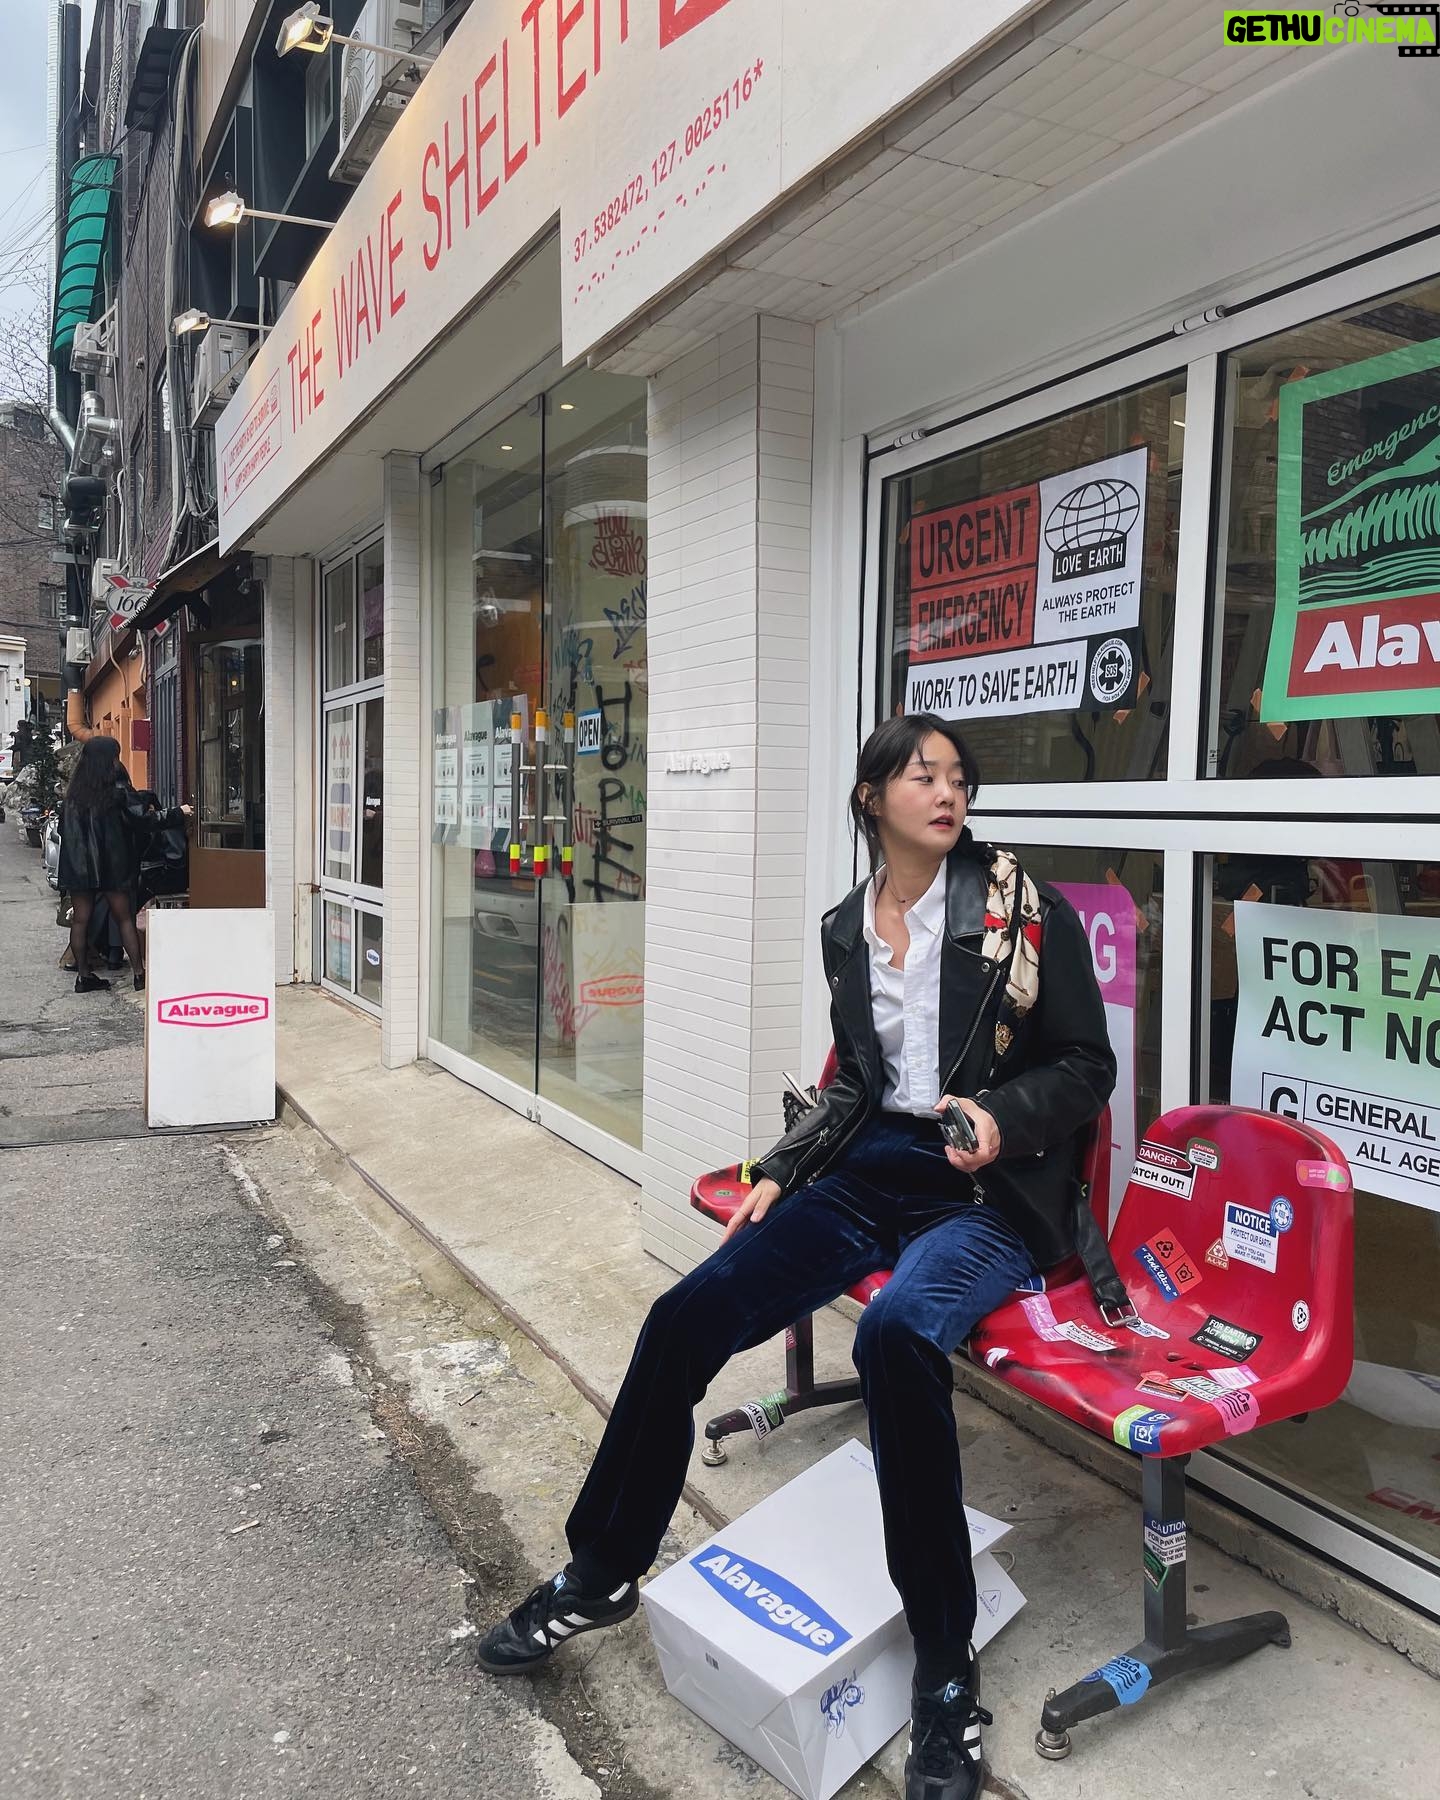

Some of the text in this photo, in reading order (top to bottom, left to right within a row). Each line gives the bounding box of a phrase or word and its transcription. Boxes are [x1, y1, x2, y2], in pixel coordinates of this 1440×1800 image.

[288, 308, 324, 434] THE
[333, 189, 406, 379] WAVE
[1327, 405, 1440, 486] Emergenc
[918, 496, 1031, 578] URGENT
[1055, 543, 1123, 576] LOVE EARTH
[1042, 581, 1135, 612] ALWAYS PROTECT
[918, 581, 1029, 653] EMERGENCY
[1058, 601, 1116, 624] THE EARTH
[912, 660, 1079, 711] WORK TO SAVE EARTH
[579, 718, 600, 748] OPEN
[1262, 937, 1359, 992] FOR
[168, 1004, 260, 1017] Alavague
[1261, 996, 1365, 1053] ACT
[1316, 1093, 1436, 1142] GENERAL
[1140, 1147, 1178, 1167] DANGER
[1356, 1141, 1391, 1165] ALL
[1132, 1166, 1185, 1190] ATCH OUT!
[1235, 1209, 1271, 1234] NOTICE
[1230, 1227, 1272, 1249] PROTECT OUR EARTH
[1080, 1324, 1118, 1345] CAUTION
[1203, 1326, 1221, 1338] ACT
[1208, 1319, 1248, 1341] FOR EARTH
[1151, 1519, 1186, 1535] CAUTION
[699, 1555, 835, 1647] Alavague
